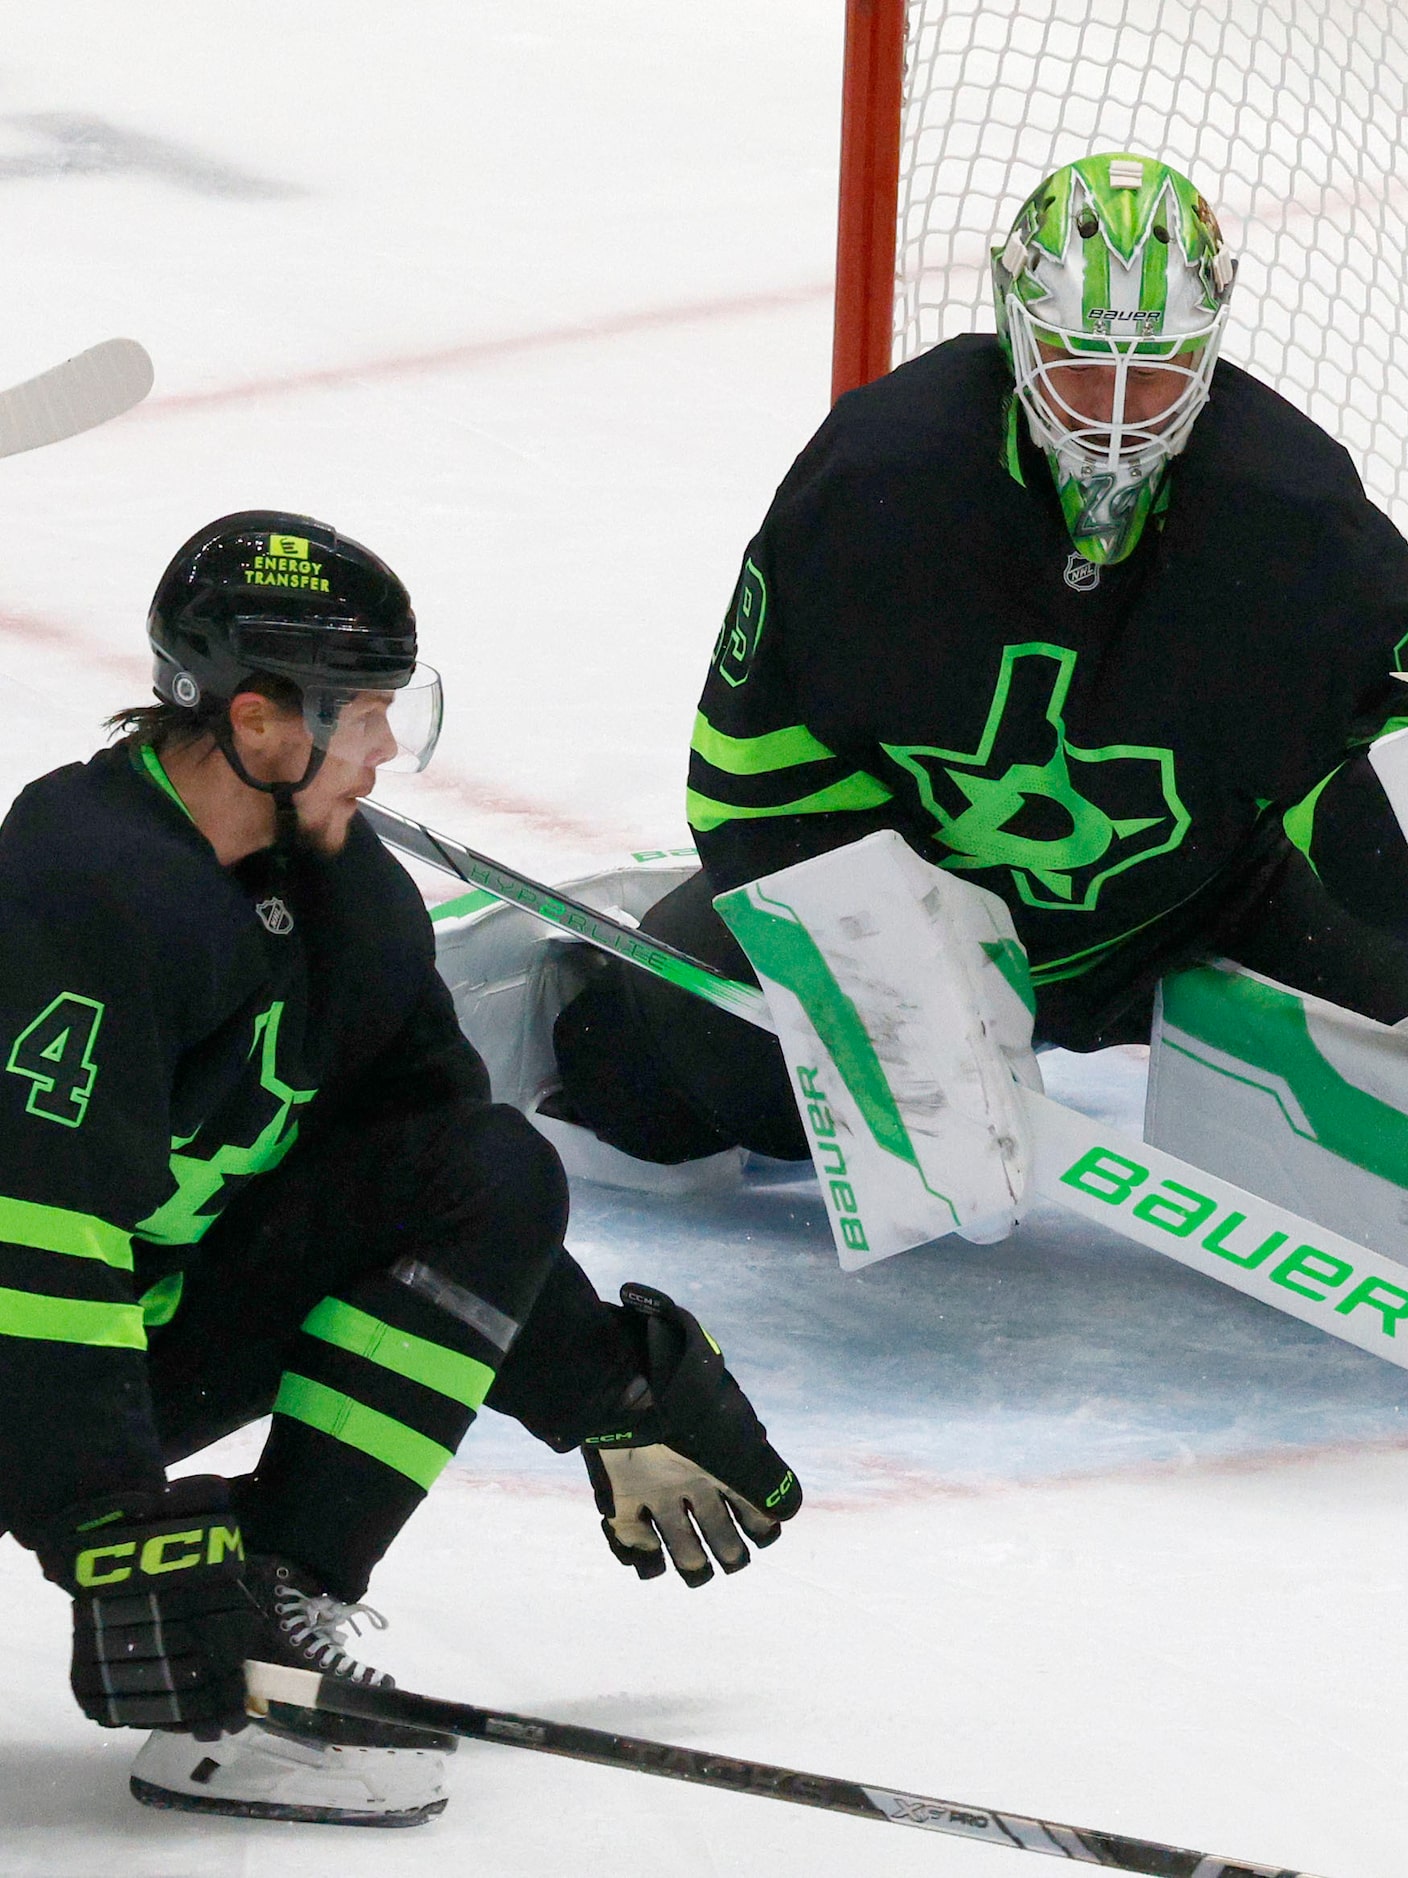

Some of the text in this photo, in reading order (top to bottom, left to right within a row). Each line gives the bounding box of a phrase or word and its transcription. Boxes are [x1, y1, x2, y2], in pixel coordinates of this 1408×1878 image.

[1088, 309, 1161, 322] BAUER
[254, 556, 322, 575] ENERGY
[244, 570, 330, 592] TRANSFER
[710, 557, 766, 688] 9
[6, 991, 105, 1128] 4
[796, 1065, 870, 1251] BAUER
[585, 1432, 633, 1443] CCM
[76, 1526, 245, 1588] CCM
[949, 1809, 988, 1829] PRO
